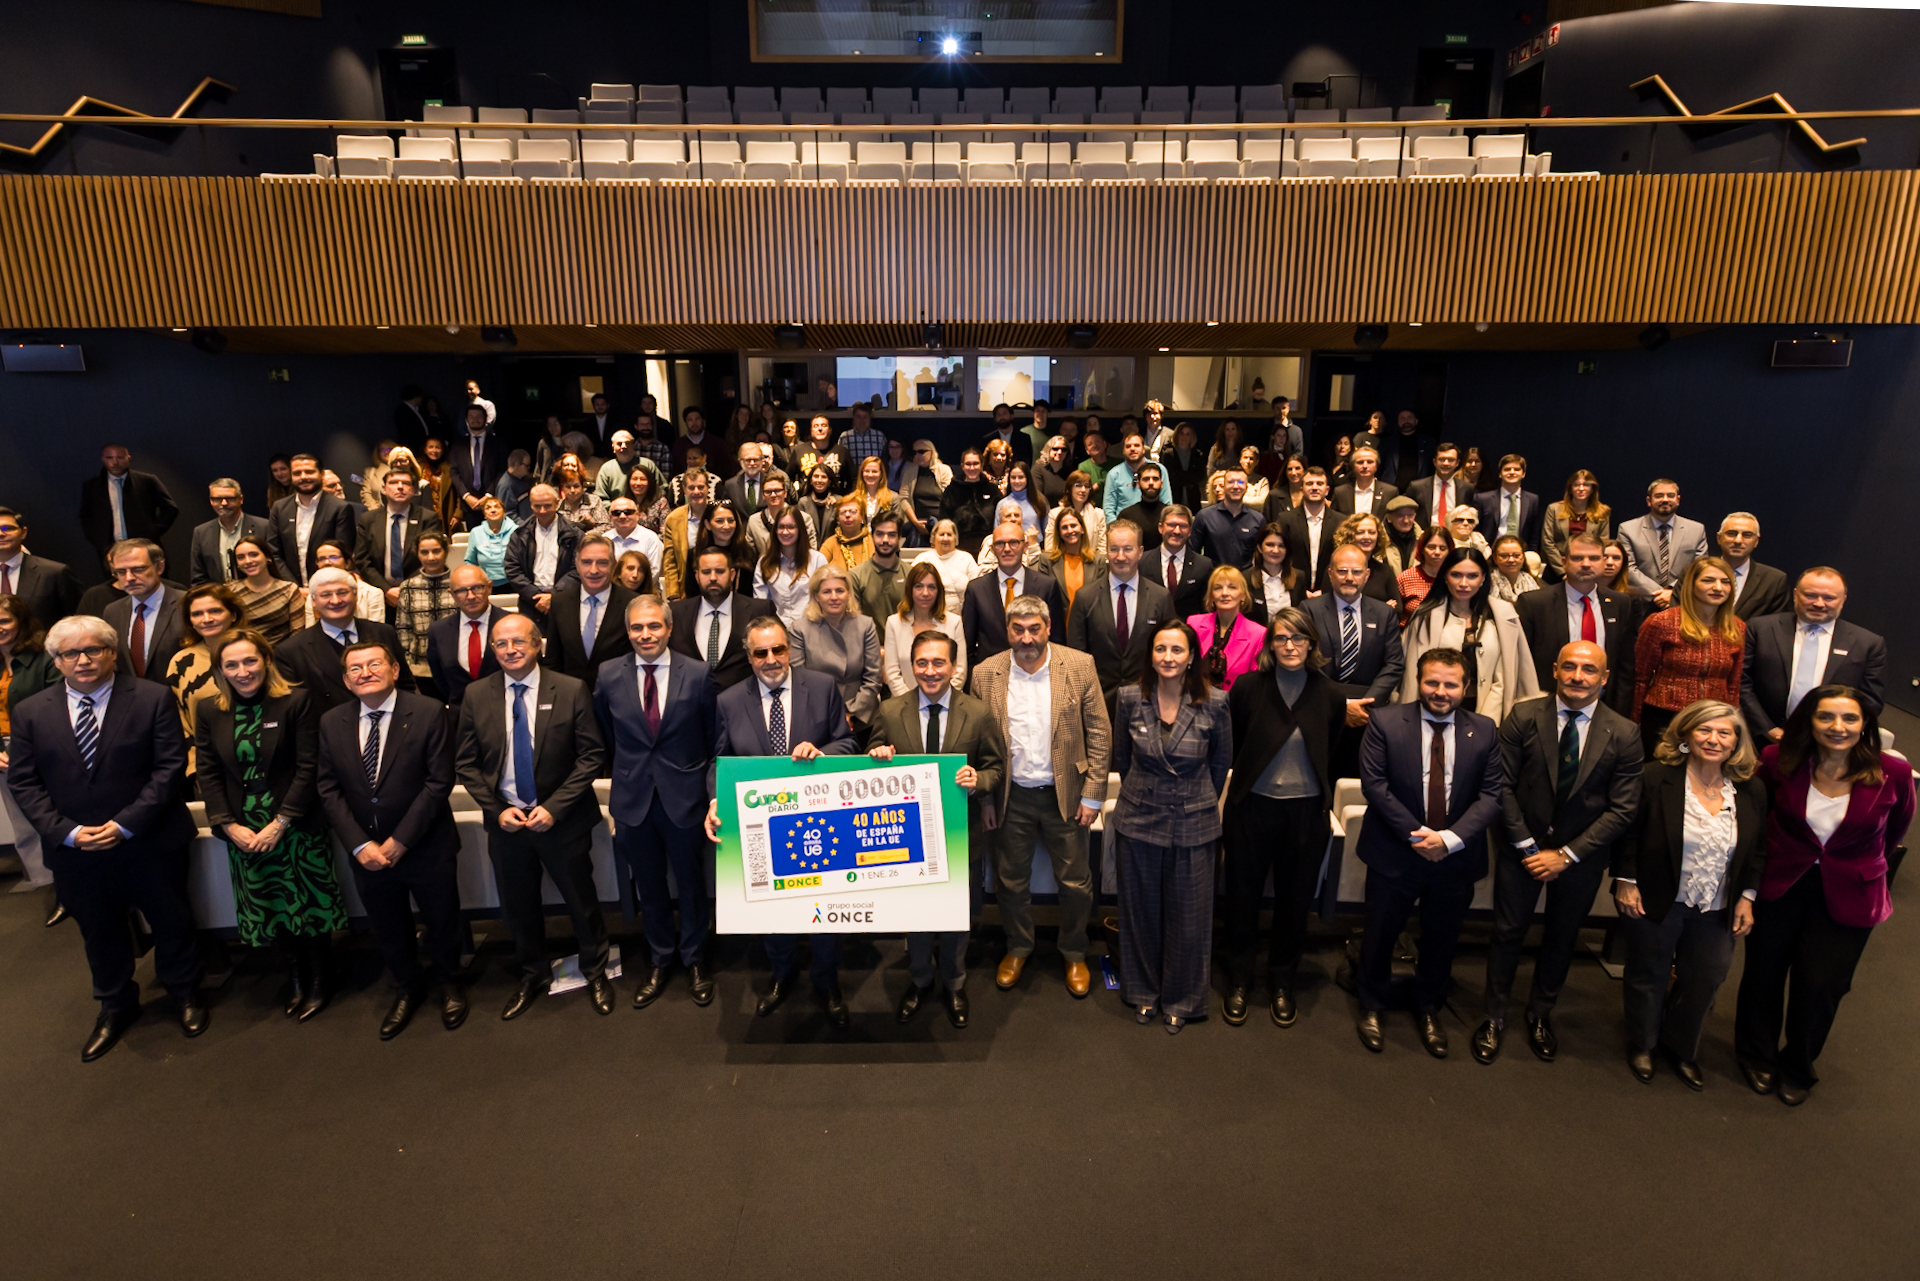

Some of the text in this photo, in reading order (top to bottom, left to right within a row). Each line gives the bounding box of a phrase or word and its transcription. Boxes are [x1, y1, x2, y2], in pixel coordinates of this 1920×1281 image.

[804, 783, 830, 797] 000
[839, 774, 916, 801] 00000
[808, 797, 828, 806] SERIE
[853, 808, 906, 827] 40 AÑOS
[802, 829, 822, 840] 40
[856, 824, 904, 838] DE ESPAÑA
[861, 835, 901, 847] EN LA UE
[888, 869, 899, 878] 26
[787, 876, 820, 888] ONCE
[827, 900, 874, 911] grupo social
[827, 911, 874, 924] ONCE
